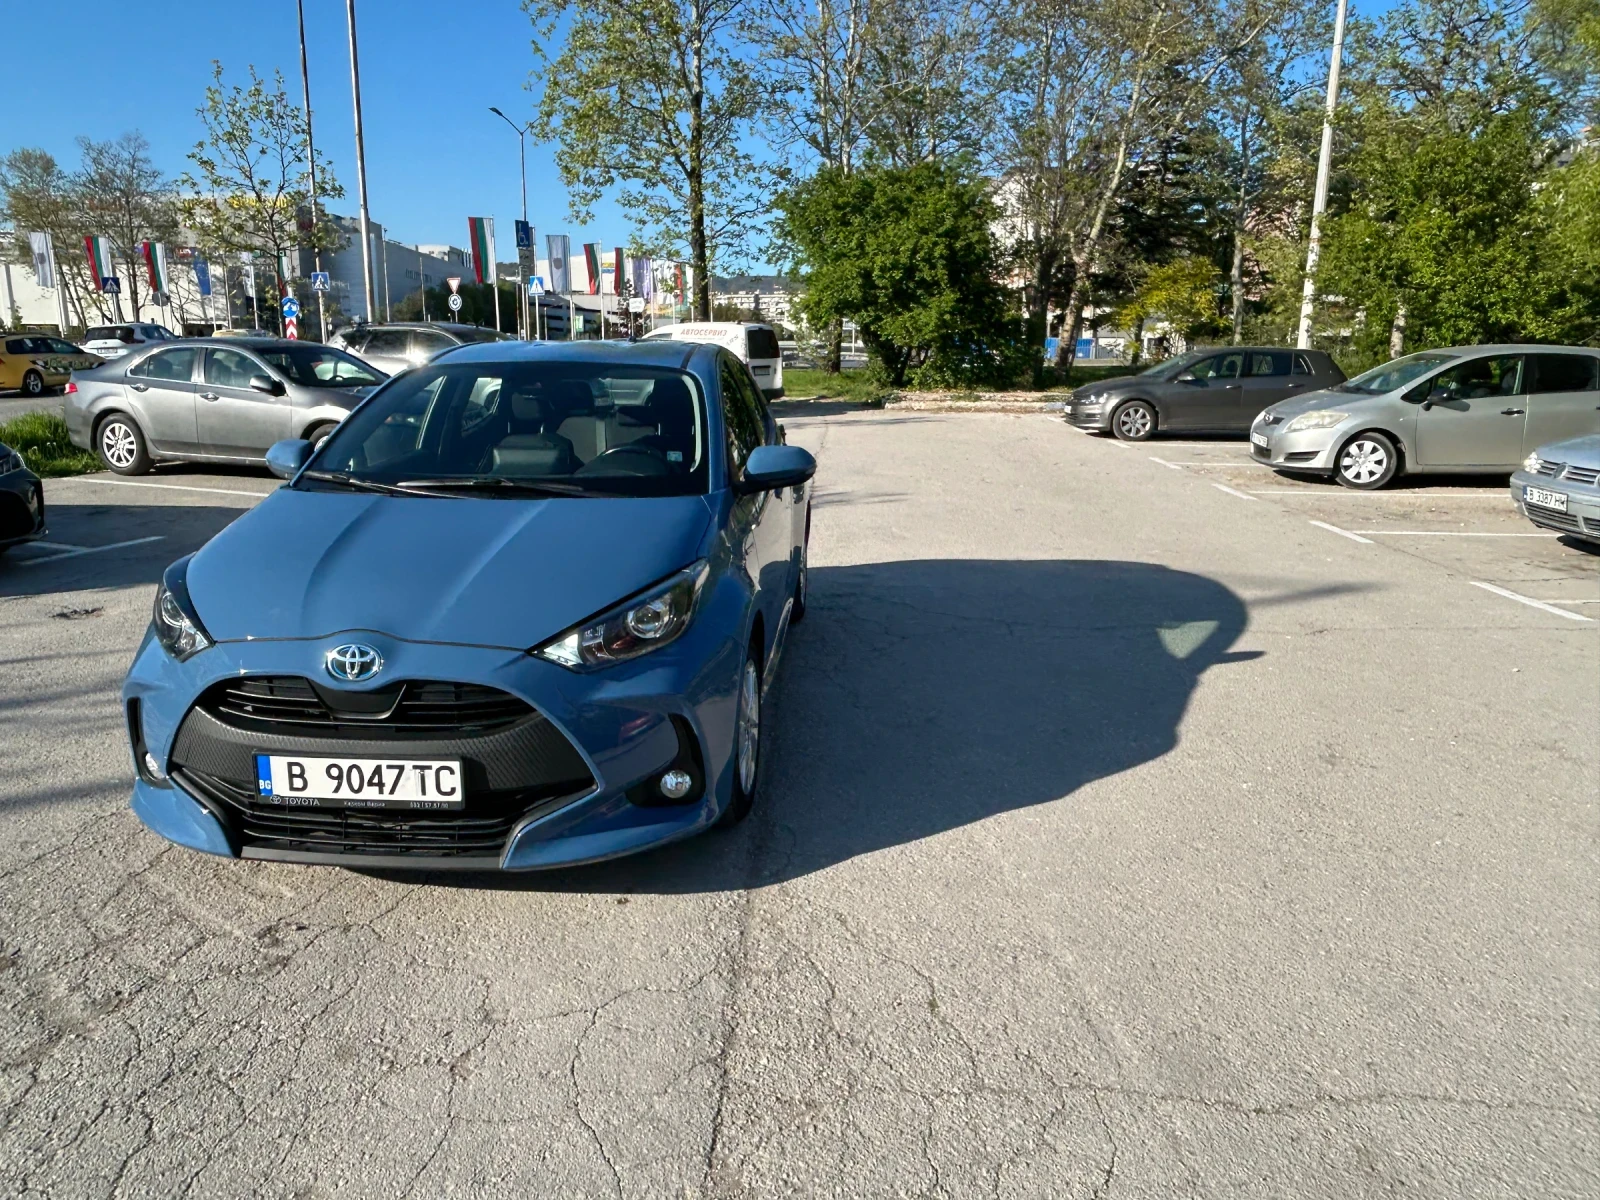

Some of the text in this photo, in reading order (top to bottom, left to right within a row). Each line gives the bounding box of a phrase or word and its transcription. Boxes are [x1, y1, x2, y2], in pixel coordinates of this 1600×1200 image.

[680, 328, 728, 337] АВТОСЕРВИЗ
[286, 761, 457, 797] B 9047 TC
[259, 779, 272, 790] BG
[284, 797, 321, 806] TOYOTA
